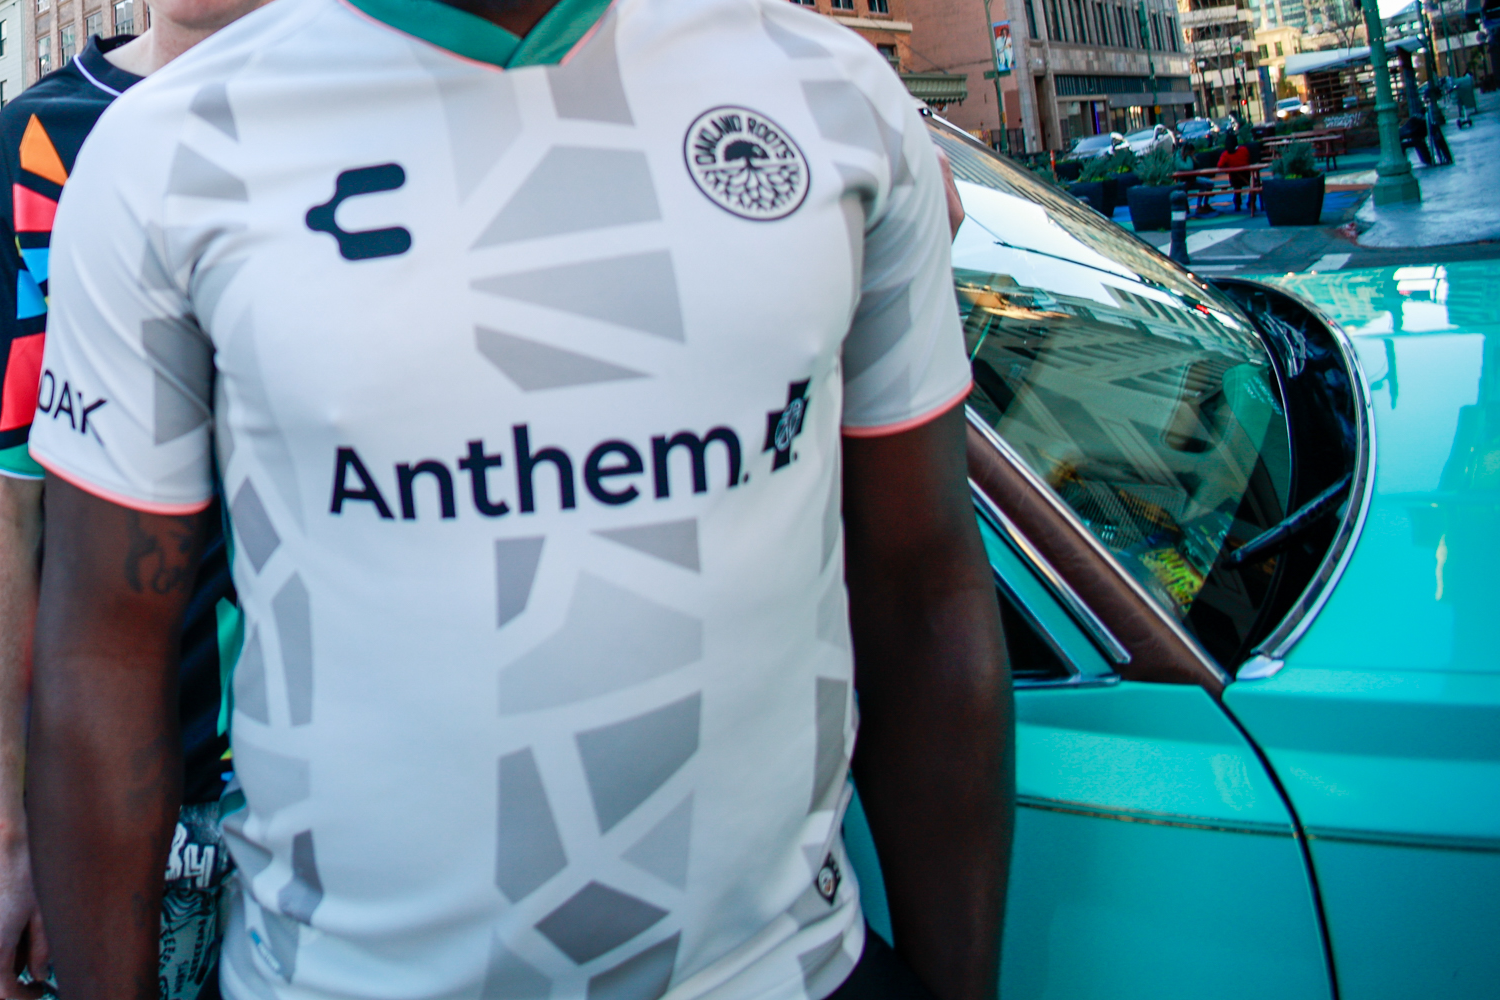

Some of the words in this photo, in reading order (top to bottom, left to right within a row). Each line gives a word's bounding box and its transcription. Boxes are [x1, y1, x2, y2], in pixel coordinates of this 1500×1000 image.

[694, 115, 742, 166] OAKLAND
[747, 116, 795, 160] ROOTS
[37, 369, 108, 447] OAK
